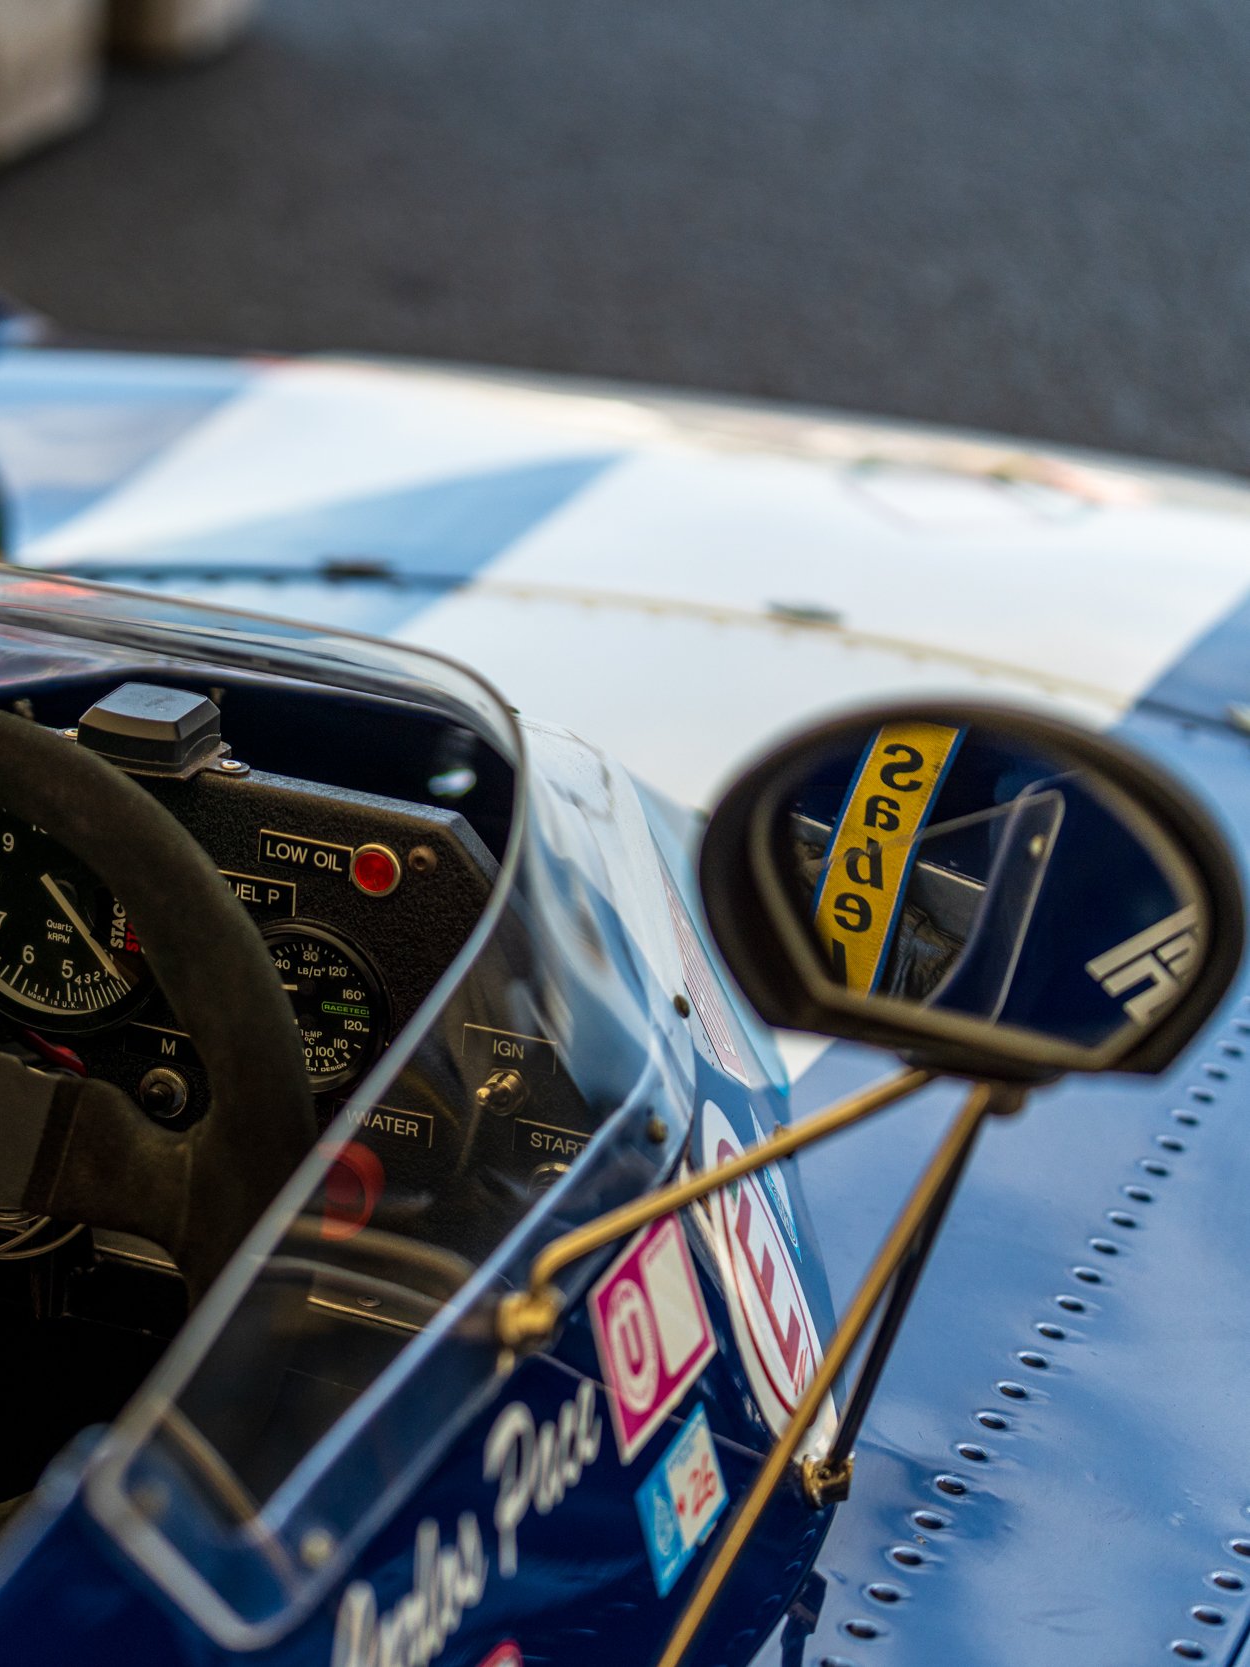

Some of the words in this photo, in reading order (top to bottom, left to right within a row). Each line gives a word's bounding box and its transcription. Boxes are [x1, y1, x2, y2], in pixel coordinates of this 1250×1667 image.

[1, 832, 15, 852] 9
[265, 840, 309, 865] LOW
[313, 851, 343, 873] OIL
[232, 881, 262, 903] UEL
[268, 889, 280, 905] P
[46, 918, 74, 934] Quartz
[110, 897, 127, 950] STAC
[47, 931, 70, 945] kRPM
[21, 944, 35, 964] 6
[303, 950, 318, 962] 80
[61, 958, 74, 979] 5
[274, 958, 291, 971] 40
[84, 972, 92, 983] 3
[93, 971, 101, 981] 2
[329, 965, 347, 978] 120
[74, 975, 82, 985] 4
[27, 989, 46, 1002] Made
[62, 999, 80, 1009] U.K.
[342, 988, 362, 1001] 160
[344, 1019, 363, 1032] 120
[161, 1037, 176, 1057] M
[333, 1038, 349, 1050] 110
[493, 1039, 525, 1061] IGN
[315, 1045, 336, 1058] 100
[320, 1061, 348, 1072] DESIGN
